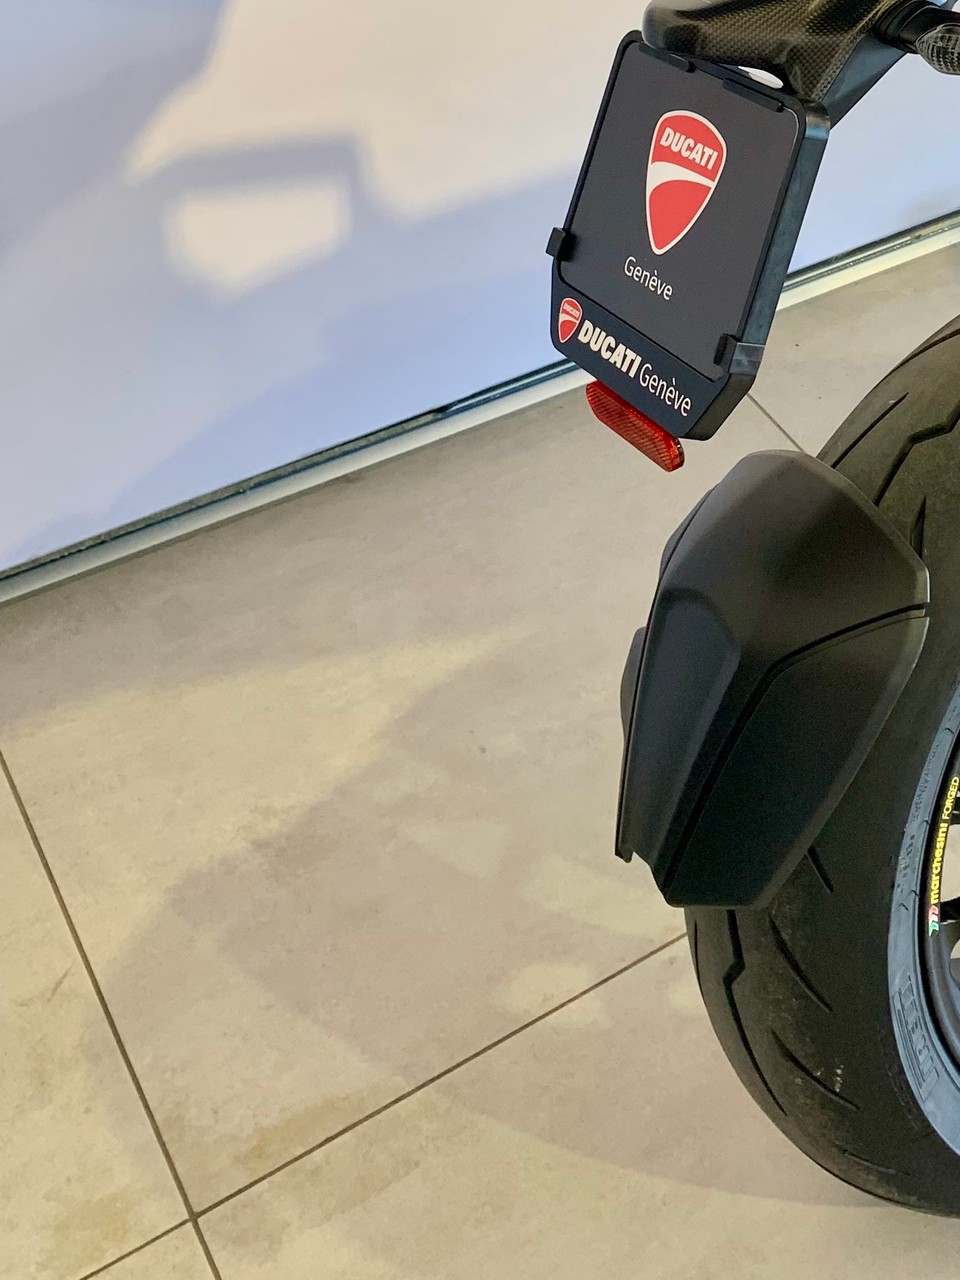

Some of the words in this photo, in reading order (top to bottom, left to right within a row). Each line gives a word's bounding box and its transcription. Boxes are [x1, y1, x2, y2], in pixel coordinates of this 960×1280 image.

[659, 126, 719, 170] DUCATI
[624, 256, 673, 301] Genève
[577, 319, 642, 379] DUCATI
[639, 363, 692, 417] Genève
[930, 822, 948, 904] marchesini
[942, 775, 960, 819] FORGED
